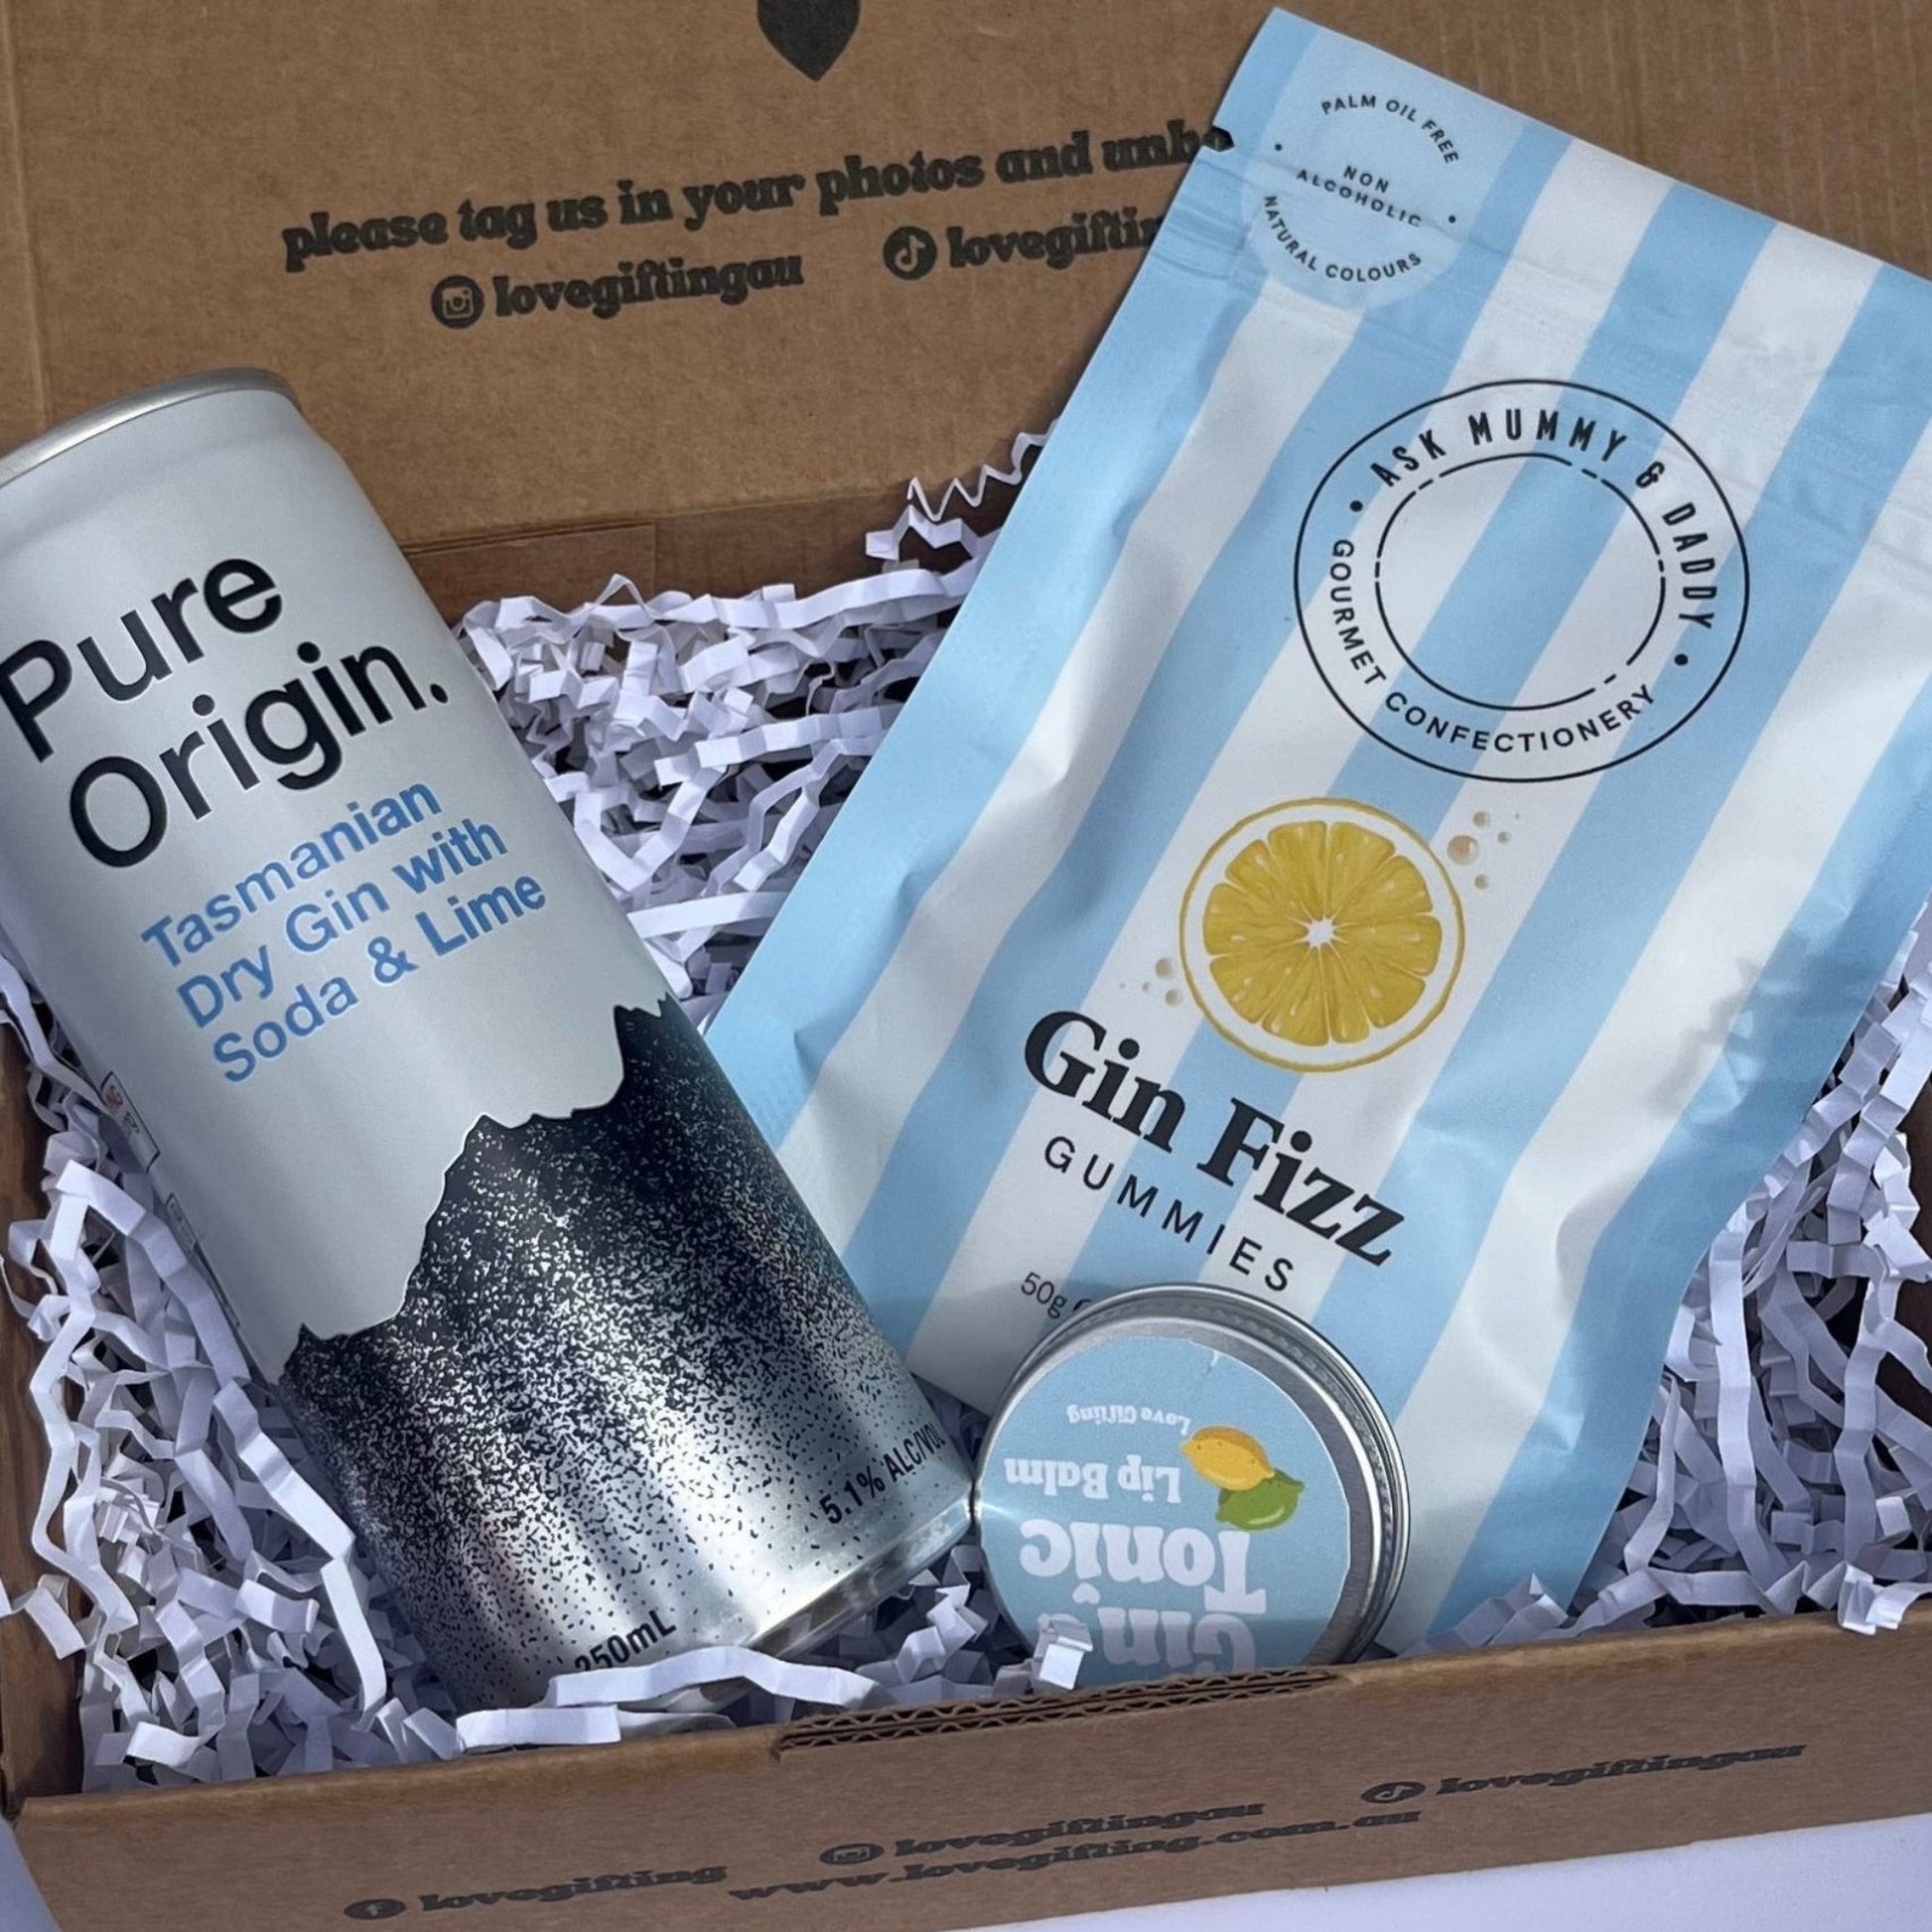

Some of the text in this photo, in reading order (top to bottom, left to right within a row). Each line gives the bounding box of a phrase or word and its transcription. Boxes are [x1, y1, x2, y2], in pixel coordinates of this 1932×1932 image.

[1321, 94, 1459, 164] PALM OIL FREE
[282, 211, 449, 273] please
[458, 200, 538, 248] tag
[546, 195, 608, 232] us
[617, 180, 673, 225] in
[682, 173, 805, 231] your
[816, 150, 985, 216] photos
[996, 130, 1094, 184] and
[1296, 169, 1422, 227] ALCOHOLIC
[1343, 165, 1390, 193] NON
[1264, 195, 1422, 282] NATURAL COLOURS
[493, 255, 804, 319] lovegiftingau
[1370, 408, 1718, 629] ASK MUMMY & DADDY
[0, 558, 283, 763] Pure
[1329, 539, 1655, 753] GOURMET CONFECTIONERY
[69, 640, 449, 868] Origin.
[141, 781, 442, 967] Tasmanian
[177, 817, 508, 1029] Dry Gin with
[211, 875, 546, 1083] Soda & Lime
[1024, 1010, 1405, 1267] Gin Fizz
[1044, 1135, 1295, 1292] GUMMIES
[1021, 1271, 1068, 1318] 50g
[1066, 1404, 1191, 1436] Love Gifting
[819, 1465, 886, 1525] 5.1%
[1004, 1453, 1181, 1504] Lip Balm
[1019, 1518, 1267, 1614] Tonic
[1097, 1606, 1256, 1674] Gin
[1435, 1744, 1807, 1796] lovegiftingau
[728, 1809, 1423, 1900] www.lovegifting.com.au
[894, 1802, 1266, 1857] lovegiftingau
[418, 1864, 729, 1911] lovegifting
